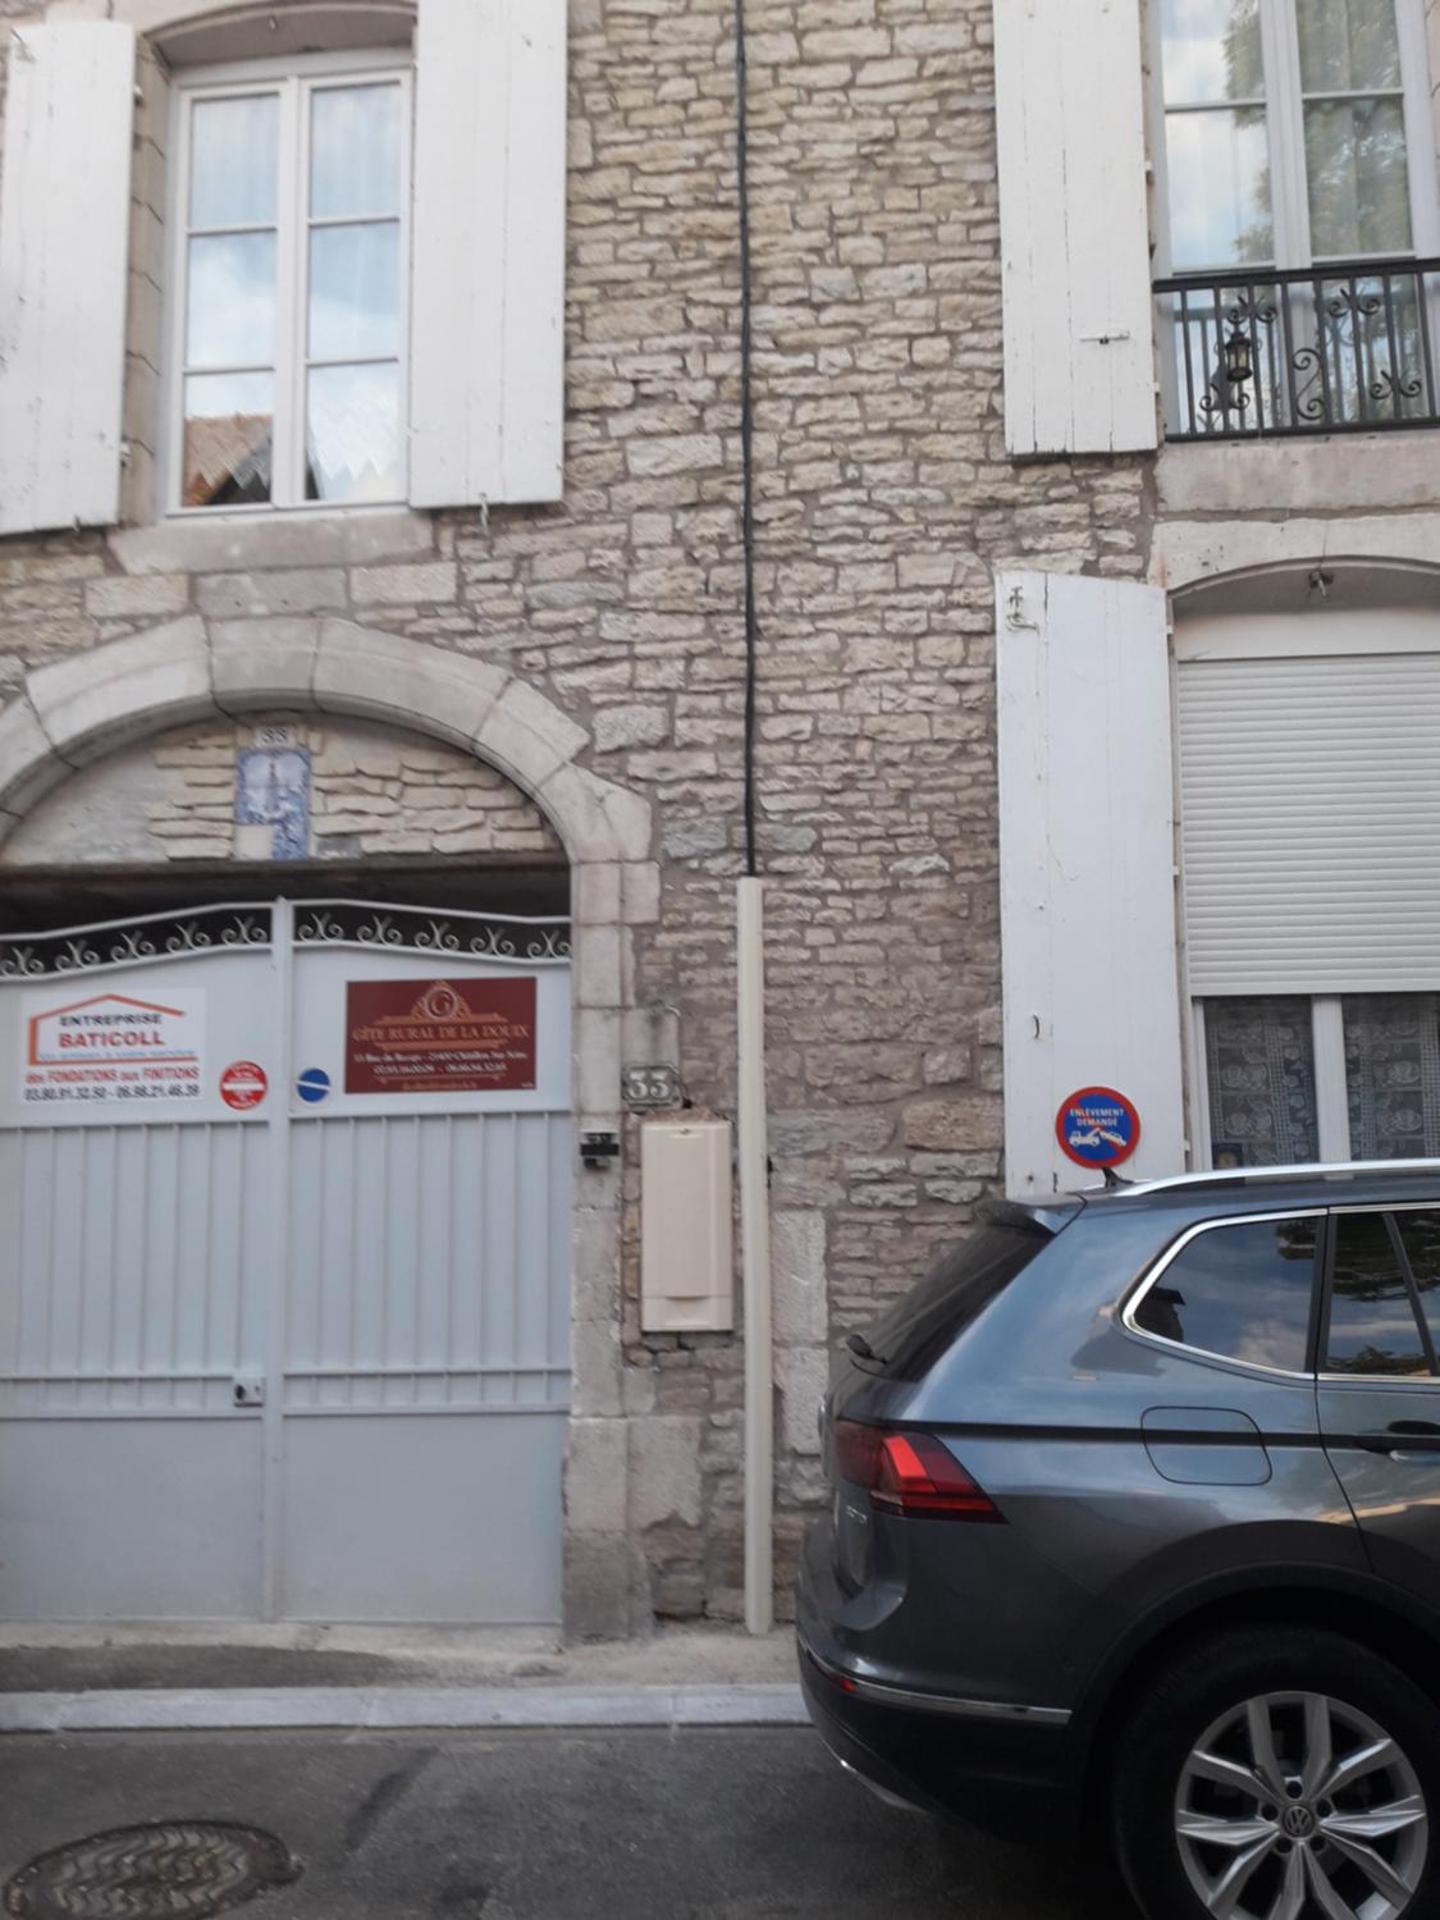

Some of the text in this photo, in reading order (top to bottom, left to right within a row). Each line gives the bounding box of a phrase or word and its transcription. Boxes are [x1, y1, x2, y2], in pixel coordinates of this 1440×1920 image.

[59, 1014, 162, 1027] ENTREPRISE
[58, 1030, 166, 1049] BATICOLL
[628, 1070, 669, 1099] 33
